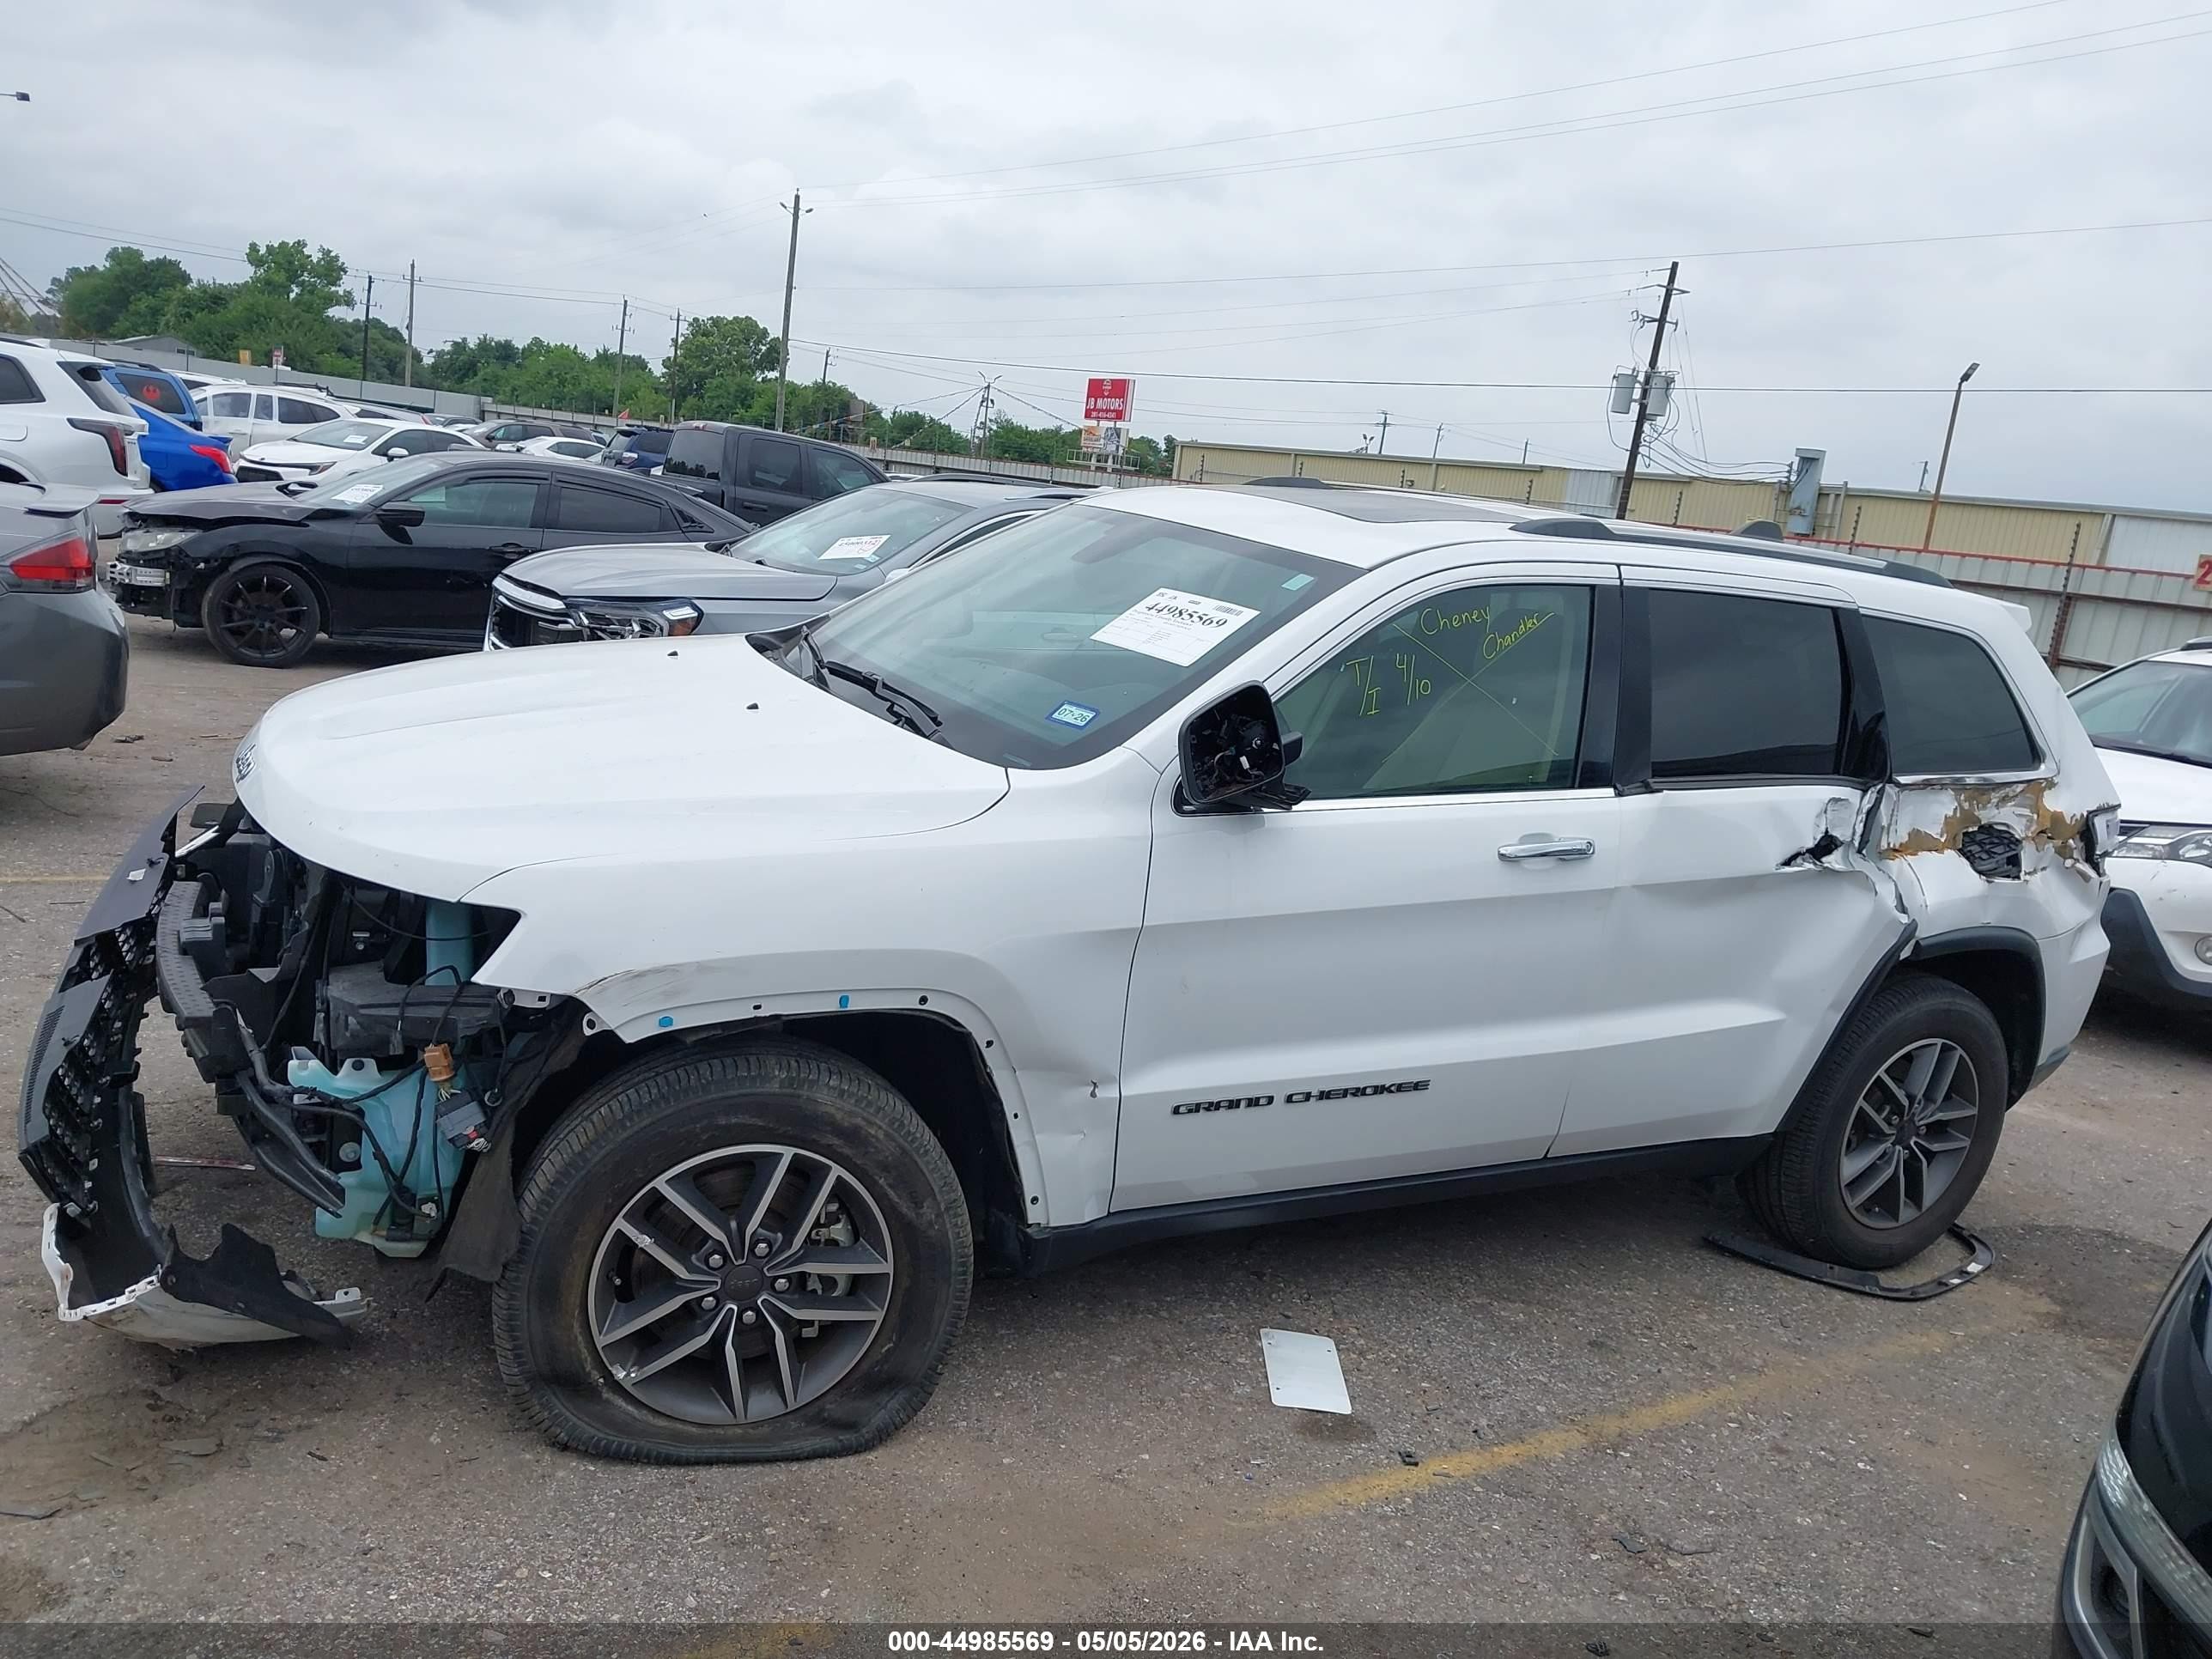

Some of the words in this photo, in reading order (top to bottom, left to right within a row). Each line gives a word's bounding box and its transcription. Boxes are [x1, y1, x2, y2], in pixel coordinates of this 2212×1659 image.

[1086, 398, 1096, 410] JB
[1097, 398, 1124, 410] MOTORS
[1145, 601, 1228, 629] 44985569
[1420, 605, 1491, 635] Cheney
[1483, 612, 1540, 659] Chandler
[1171, 1094, 1274, 1116] GRAND
[1285, 1079, 1431, 1104] CHEROKEE
